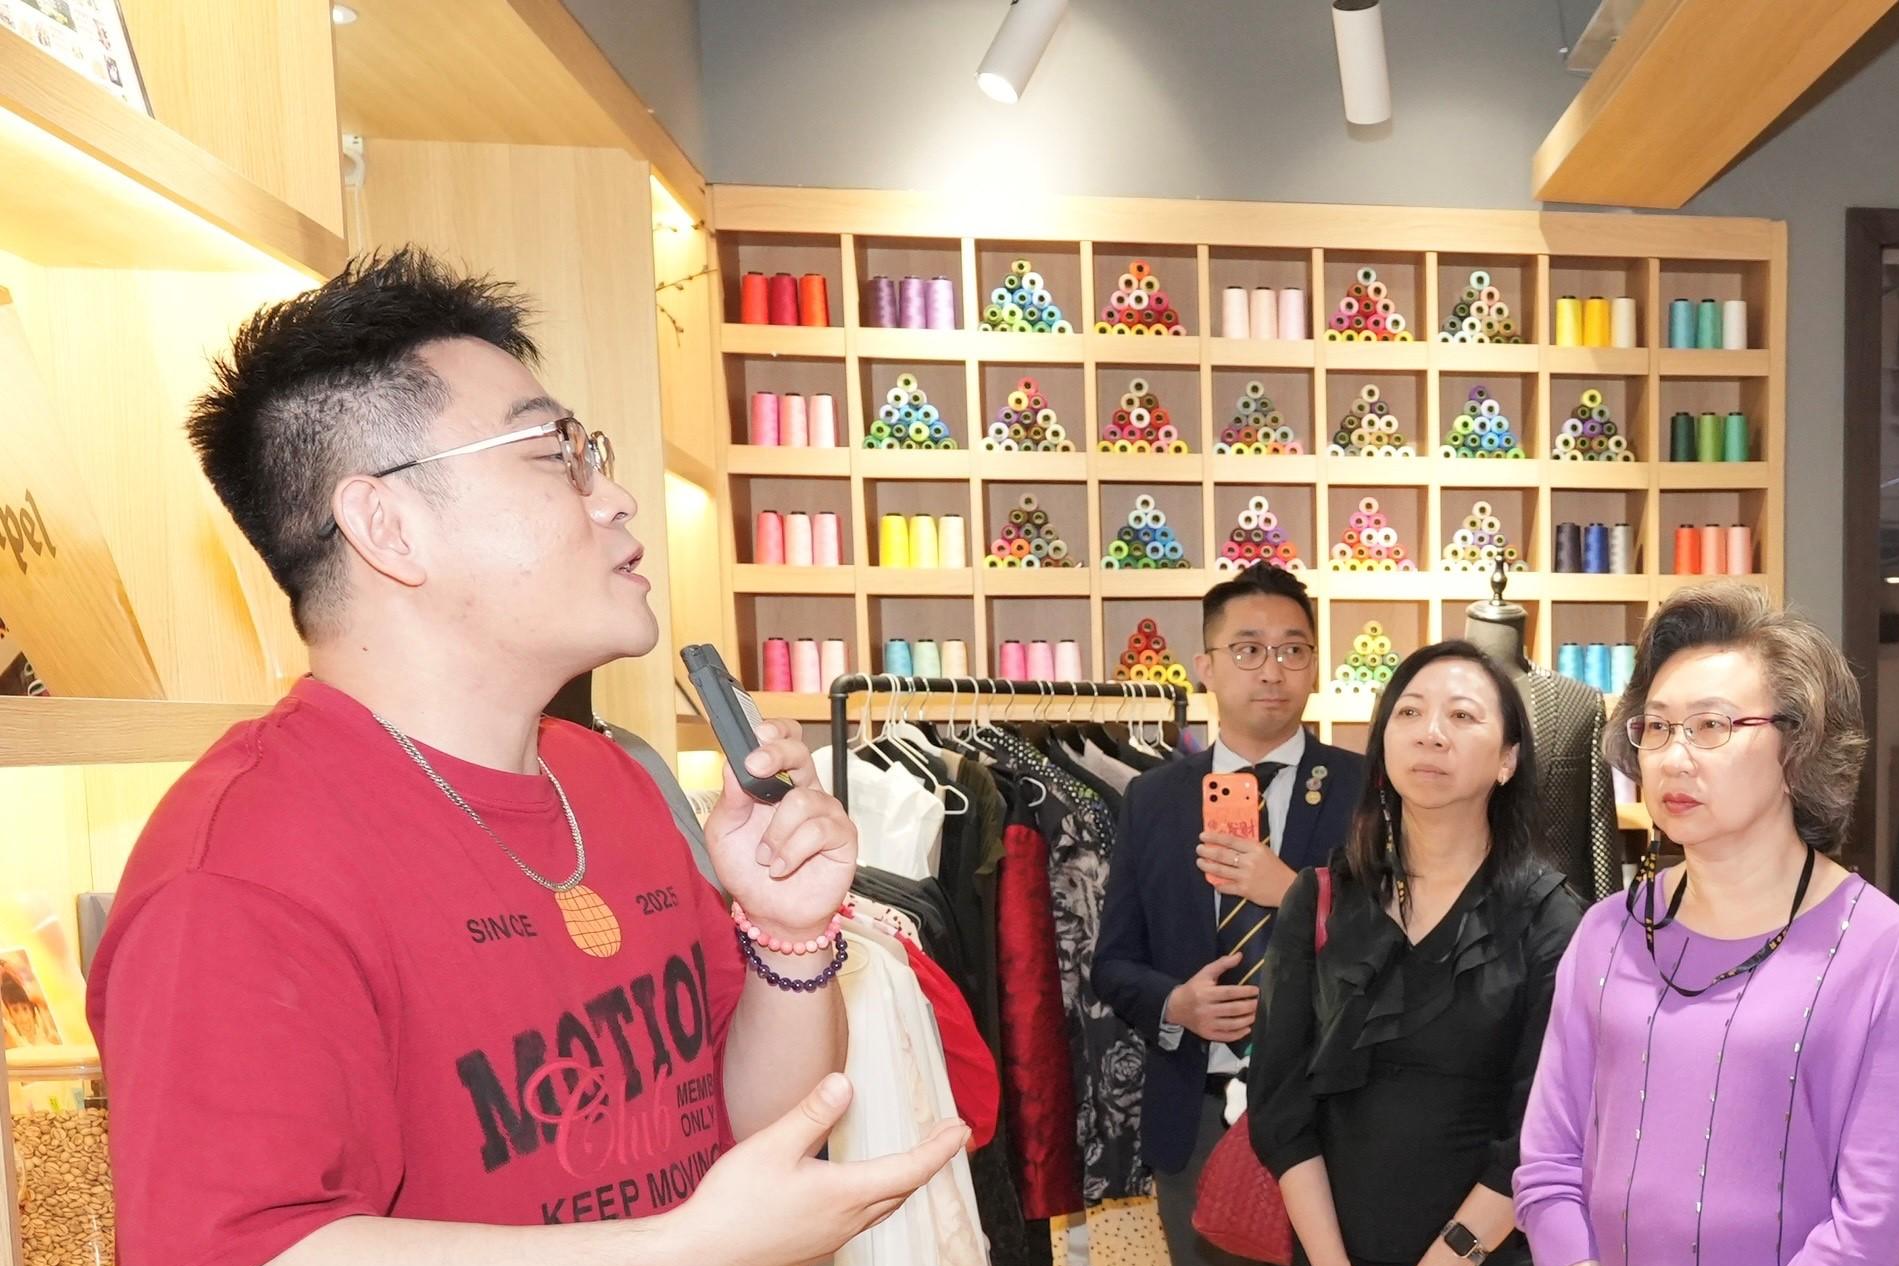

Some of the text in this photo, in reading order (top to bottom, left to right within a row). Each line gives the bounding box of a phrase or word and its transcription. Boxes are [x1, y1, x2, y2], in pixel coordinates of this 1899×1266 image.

[466, 911, 537, 944] SINCE
[681, 1103, 716, 1138] ONLY
[541, 1178, 640, 1225] KEEP
